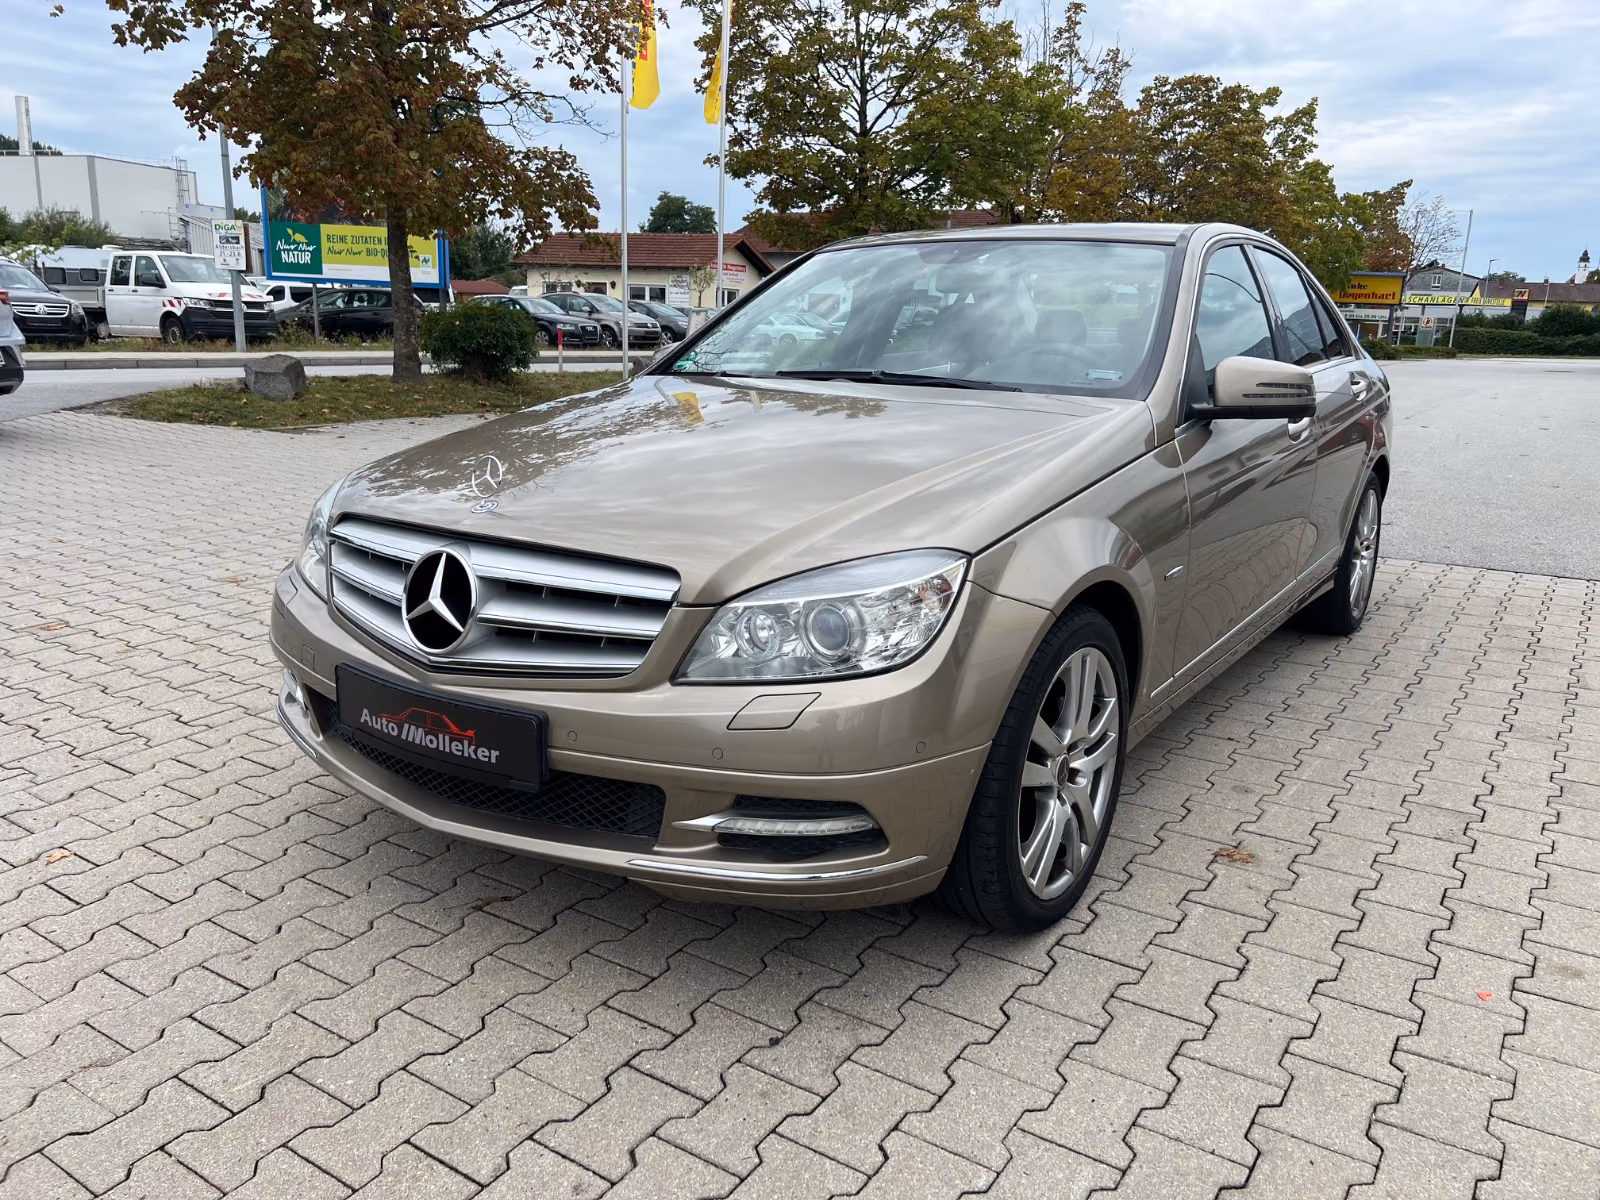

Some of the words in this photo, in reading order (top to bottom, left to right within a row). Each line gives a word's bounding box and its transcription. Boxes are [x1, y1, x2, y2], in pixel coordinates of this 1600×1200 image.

[214, 222, 236, 231] DiGA
[276, 239, 298, 250] Nur
[298, 243, 316, 251] Nur
[326, 234, 348, 244] REINE
[350, 235, 382, 246] ZUTATEN
[327, 246, 344, 256] Nur
[345, 247, 364, 256] Nur
[281, 251, 311, 264] NATUR
[360, 708, 398, 736] Auto
